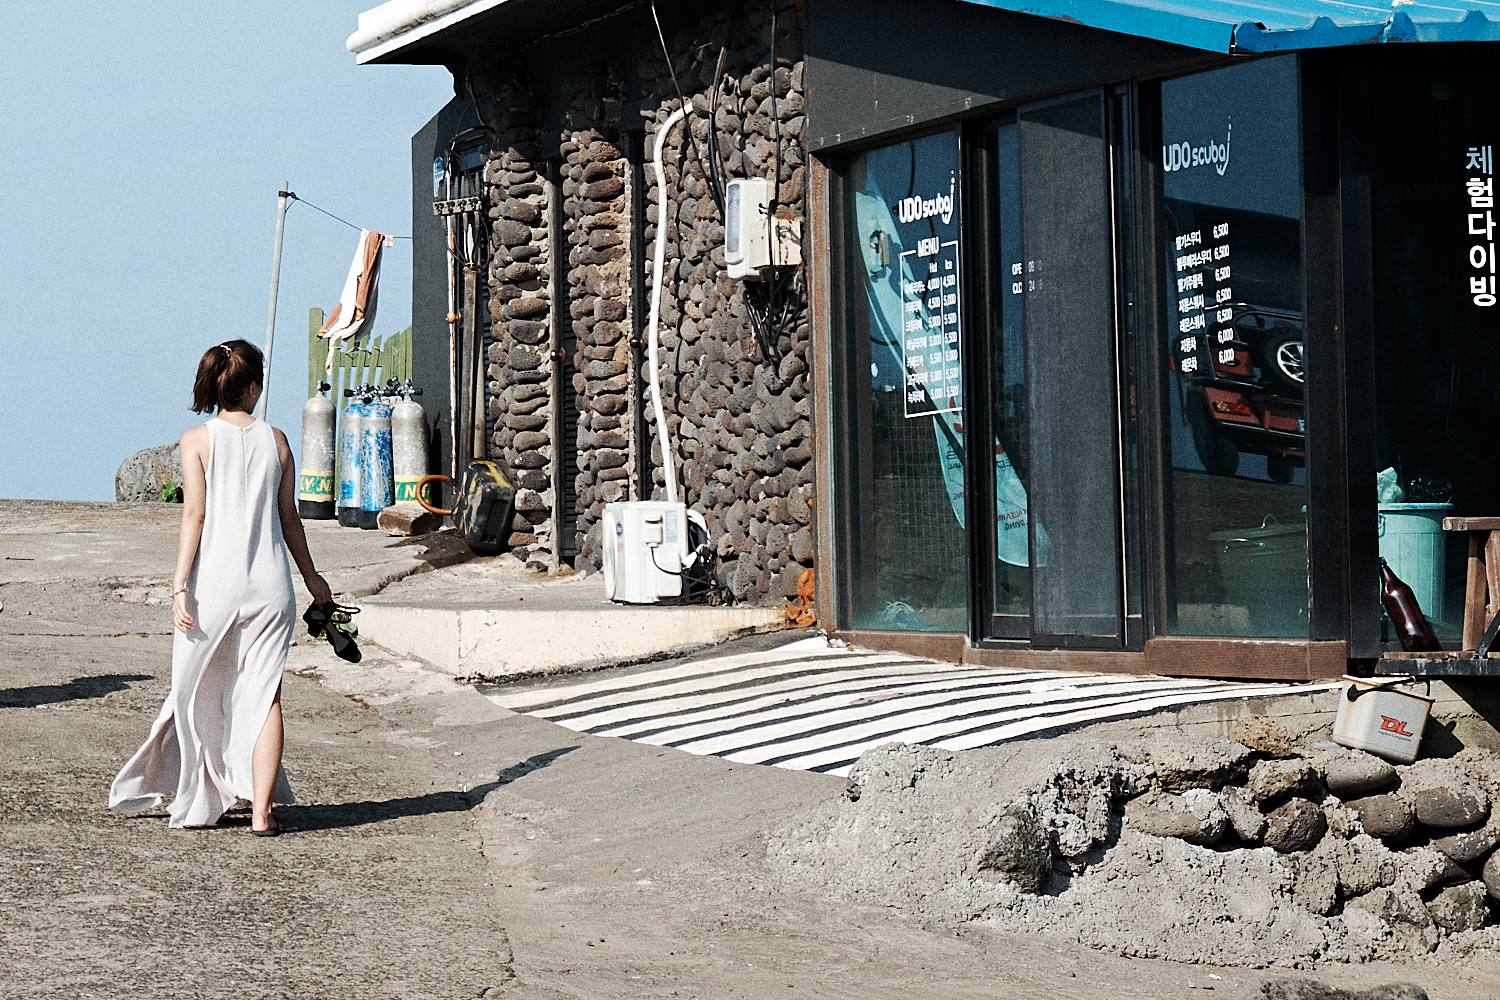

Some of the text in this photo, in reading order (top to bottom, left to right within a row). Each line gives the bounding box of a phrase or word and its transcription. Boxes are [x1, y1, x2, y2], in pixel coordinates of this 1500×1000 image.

[1162, 141, 1191, 172] UDO
[898, 195, 922, 224] UDO
[1213, 222, 1229, 239] 6,500
[1465, 145, 1497, 307] 체험다이빙
[917, 236, 940, 258] MENU
[1214, 244, 1230, 260] 6,500
[1011, 262, 1023, 275] OPE
[1215, 265, 1231, 282] 6,500
[1216, 287, 1232, 303] 6,500
[1217, 308, 1233, 323] 6,500
[1218, 328, 1234, 344] 6,000
[1219, 348, 1235, 364] 6,000
[1380, 714, 1414, 737] DL
